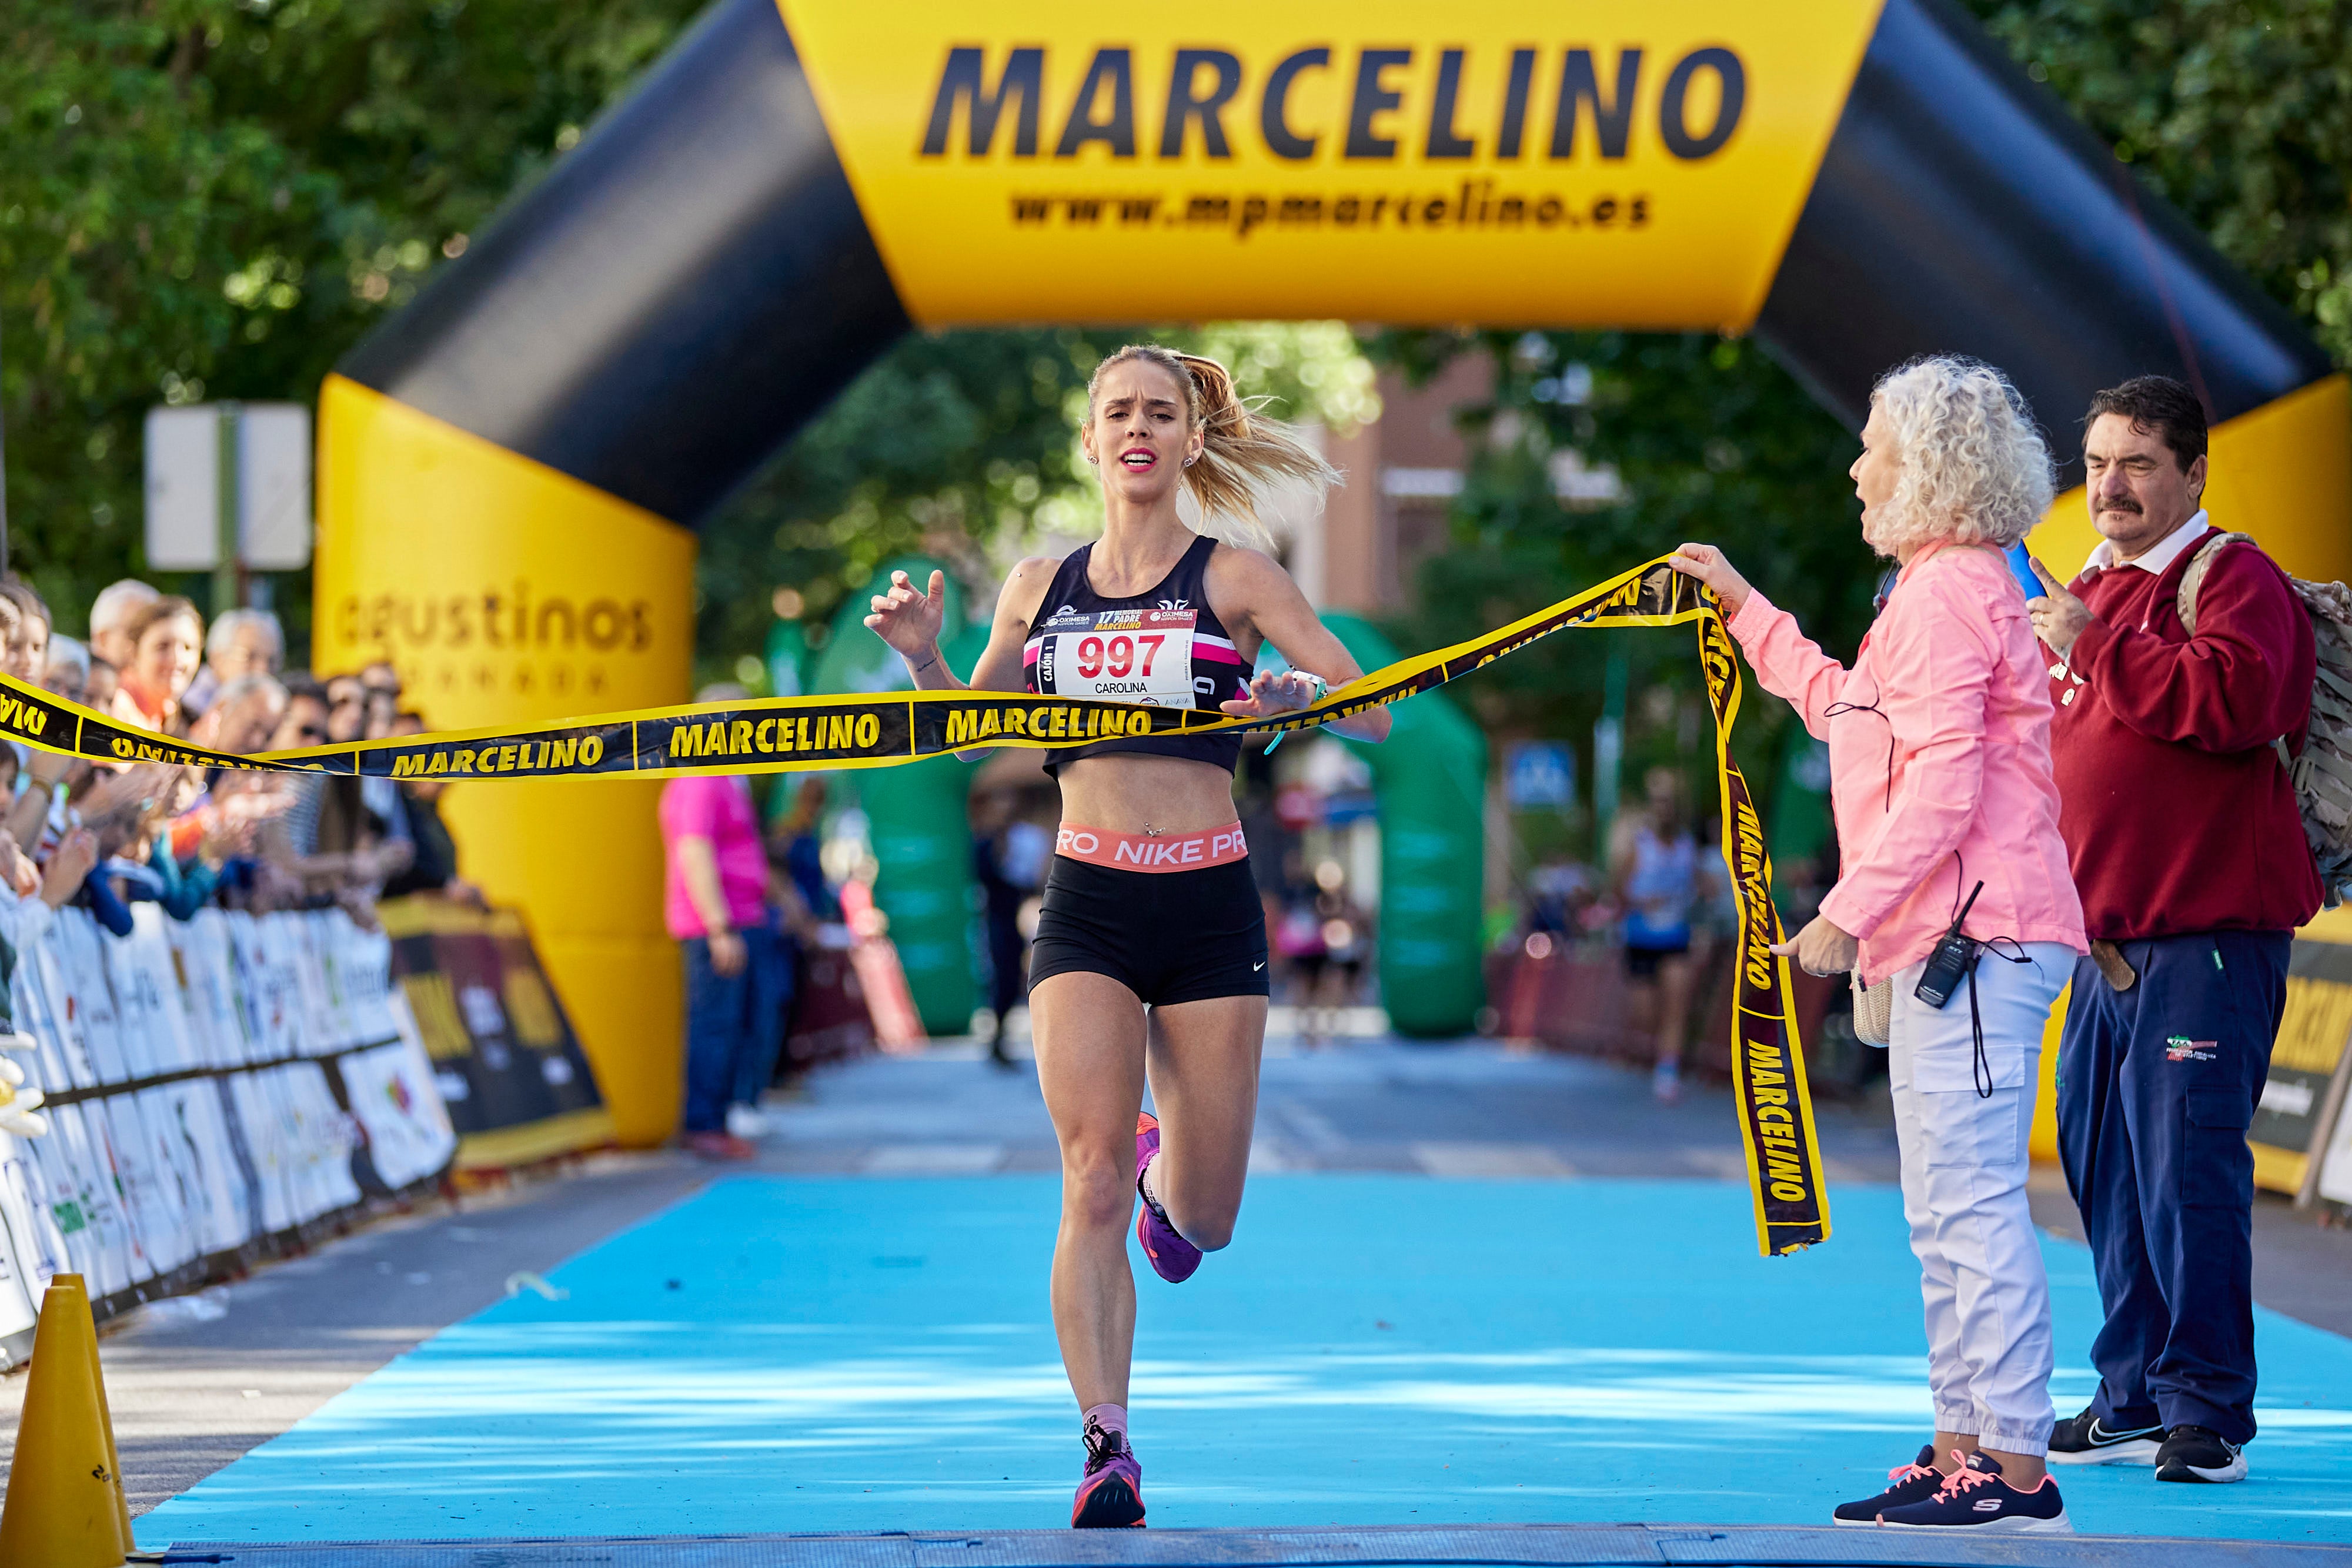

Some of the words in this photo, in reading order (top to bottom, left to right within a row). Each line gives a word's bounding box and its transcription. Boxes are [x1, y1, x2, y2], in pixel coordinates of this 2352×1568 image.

[917, 46, 1749, 162] MARCELINO
[1008, 180, 1655, 236] www.mpmarcelino.es
[1094, 621, 1141, 631] MARCELINO
[1100, 611, 1115, 623] 17
[1113, 614, 1141, 623] PADRE
[1041, 653, 1053, 682] CAJÓN
[1078, 634, 1165, 679] 997
[1095, 682, 1147, 694] CAROLINA
[669, 714, 880, 757] MARCELINO
[946, 706, 1151, 743] MARCELINO
[390, 735, 603, 777] MARCELINO
[1114, 838, 1204, 865] NIKE
[1748, 1038, 1806, 1203] MARCELINO
